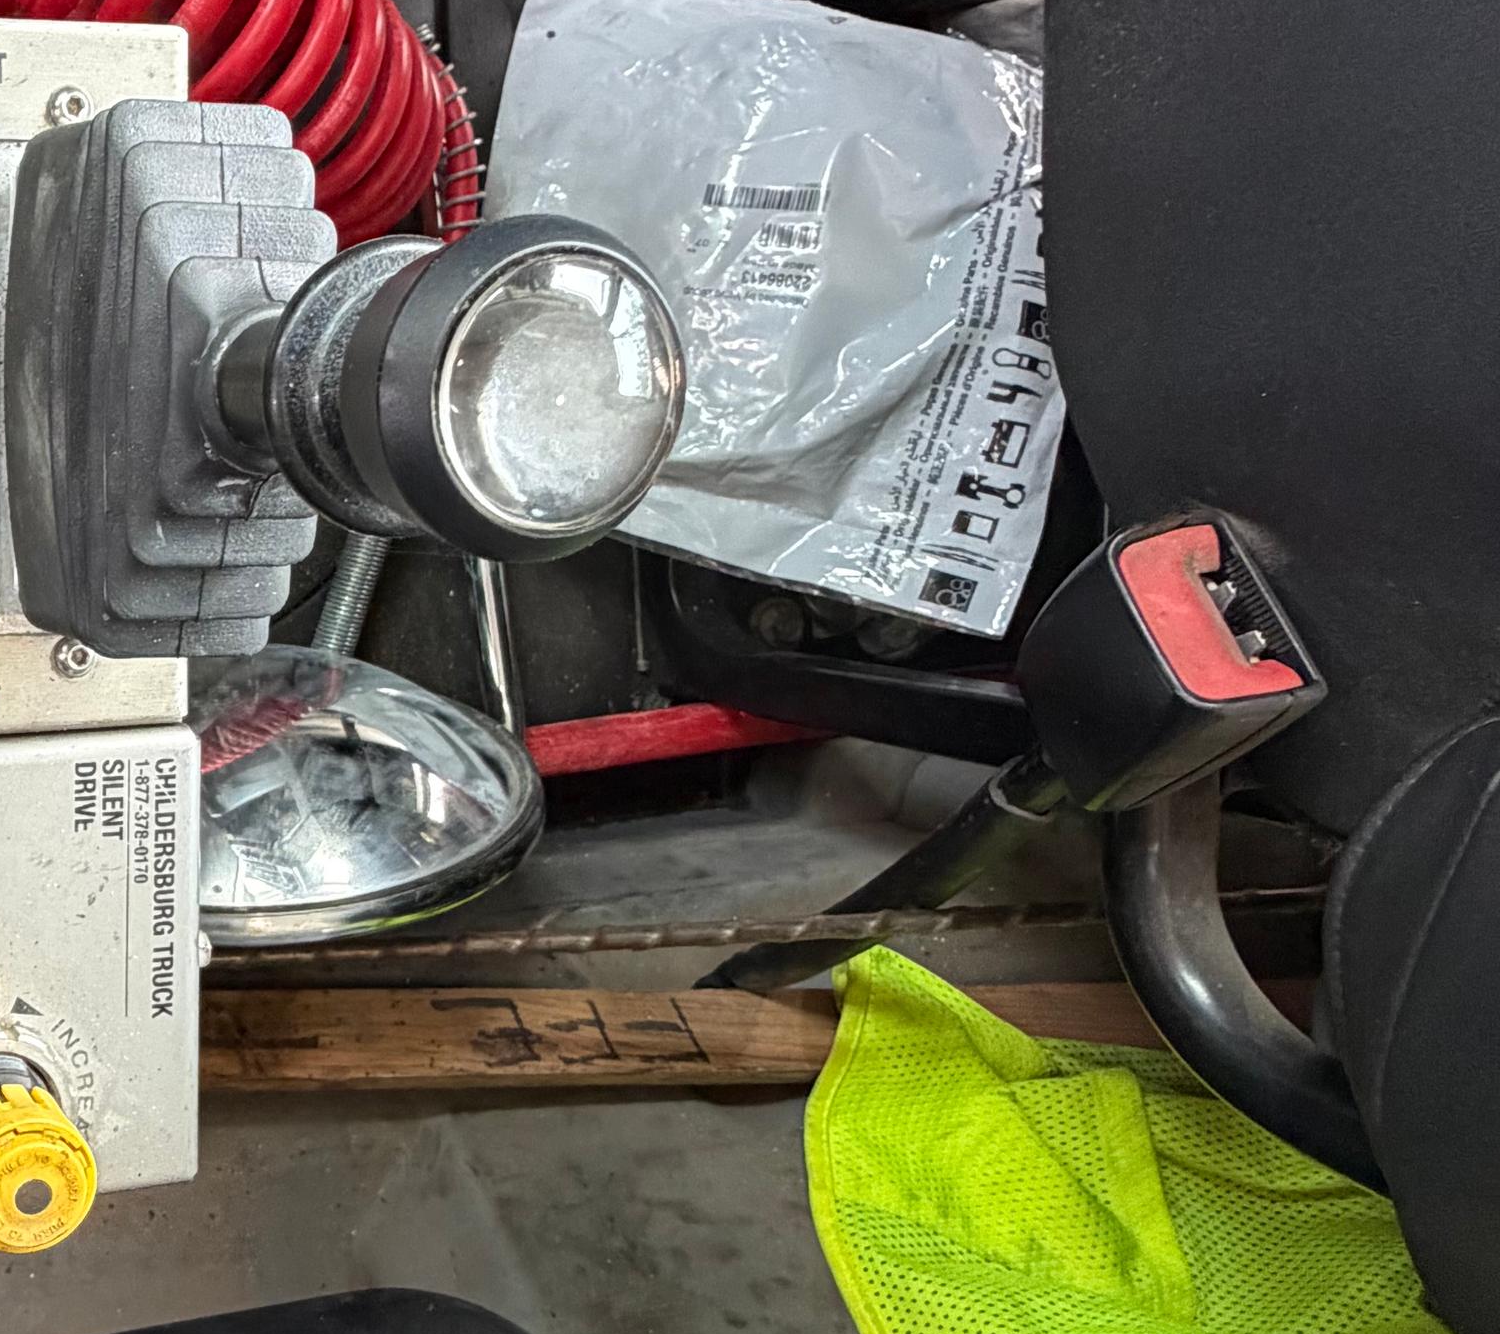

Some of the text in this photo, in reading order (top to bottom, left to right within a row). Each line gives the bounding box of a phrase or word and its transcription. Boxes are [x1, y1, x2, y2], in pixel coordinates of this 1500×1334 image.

[741, 270, 812, 293] 22086413
[74, 761, 97, 833] DRIVE
[101, 759, 125, 840] SILENT
[133, 759, 150, 884] 1-877-378-0170
[151, 757, 177, 1018] CHILDERSBURG TRUCK
